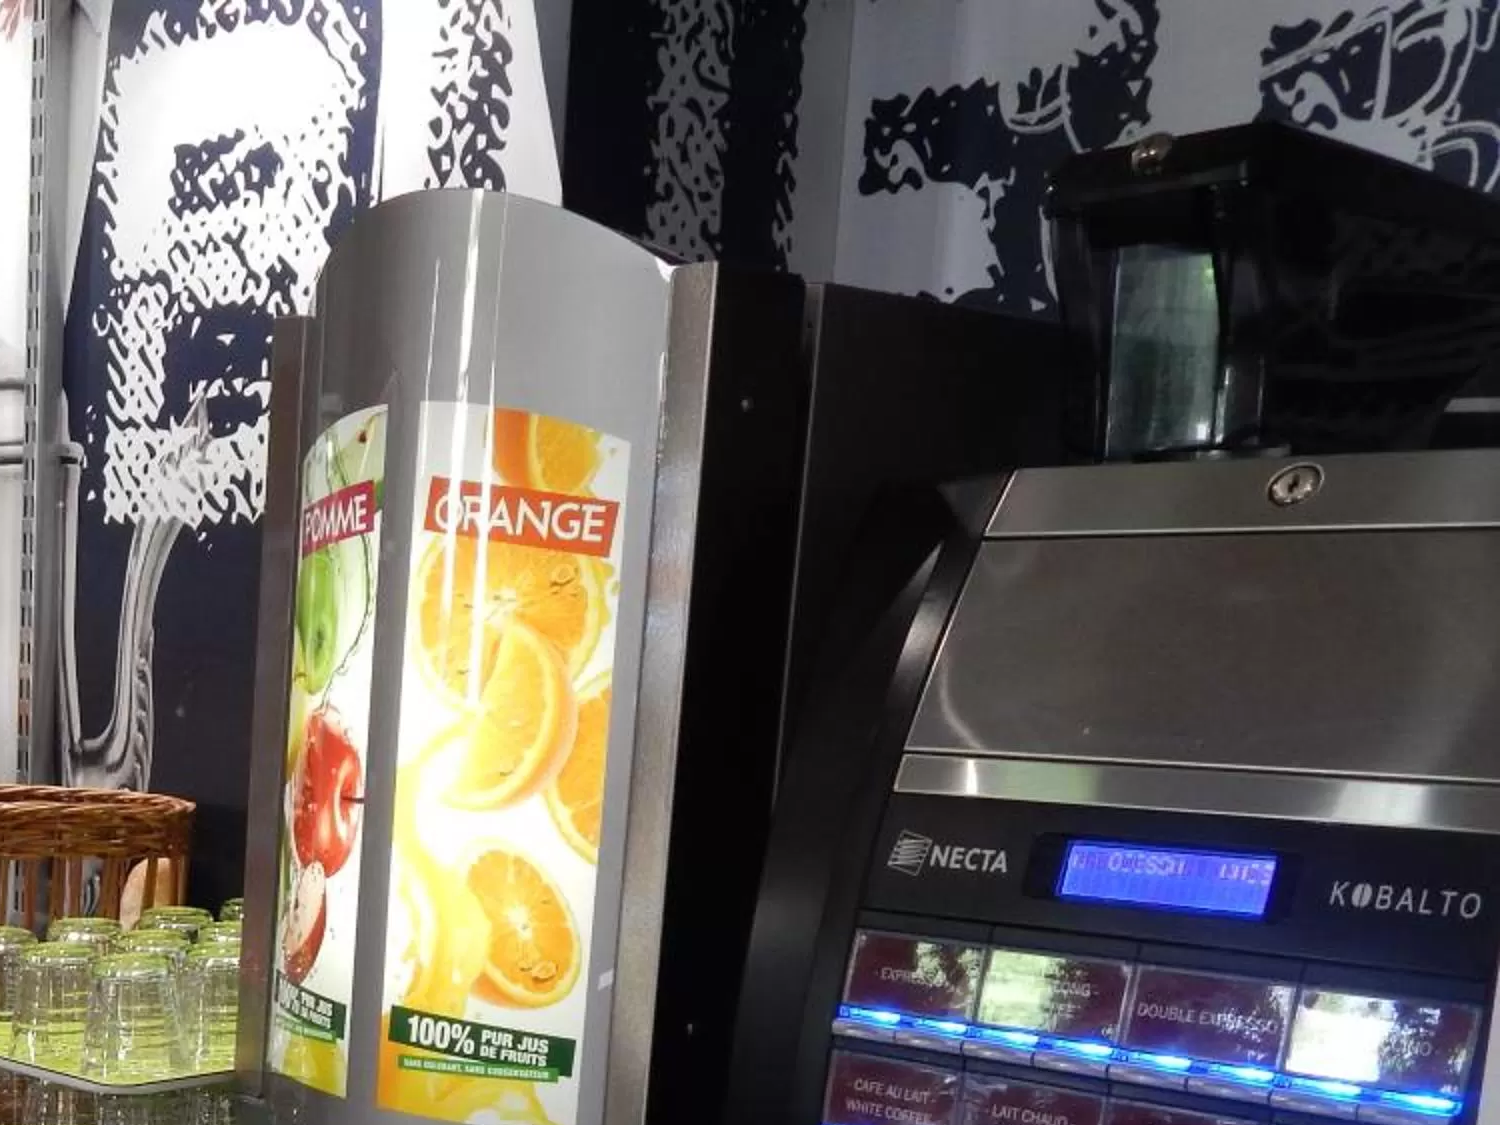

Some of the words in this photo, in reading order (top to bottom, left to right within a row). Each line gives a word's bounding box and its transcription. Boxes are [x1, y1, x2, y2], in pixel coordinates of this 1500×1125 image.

[304, 494, 367, 543] POMME
[434, 494, 607, 542] ORANGE
[929, 845, 1008, 873] NECTA
[1329, 880, 1482, 919] KOBALTO
[1136, 1002, 1196, 1024] DOUBLE
[407, 1015, 475, 1055] 100%
[480, 1030, 513, 1048] PUR
[517, 1038, 549, 1054] JUS
[479, 1045, 498, 1059] DE
[500, 1050, 548, 1067] FRUITS
[886, 1084, 903, 1099] AU
[904, 1087, 931, 1105] LAIT
[846, 1097, 884, 1118] WHITE
[991, 1104, 1019, 1121] LAIT
